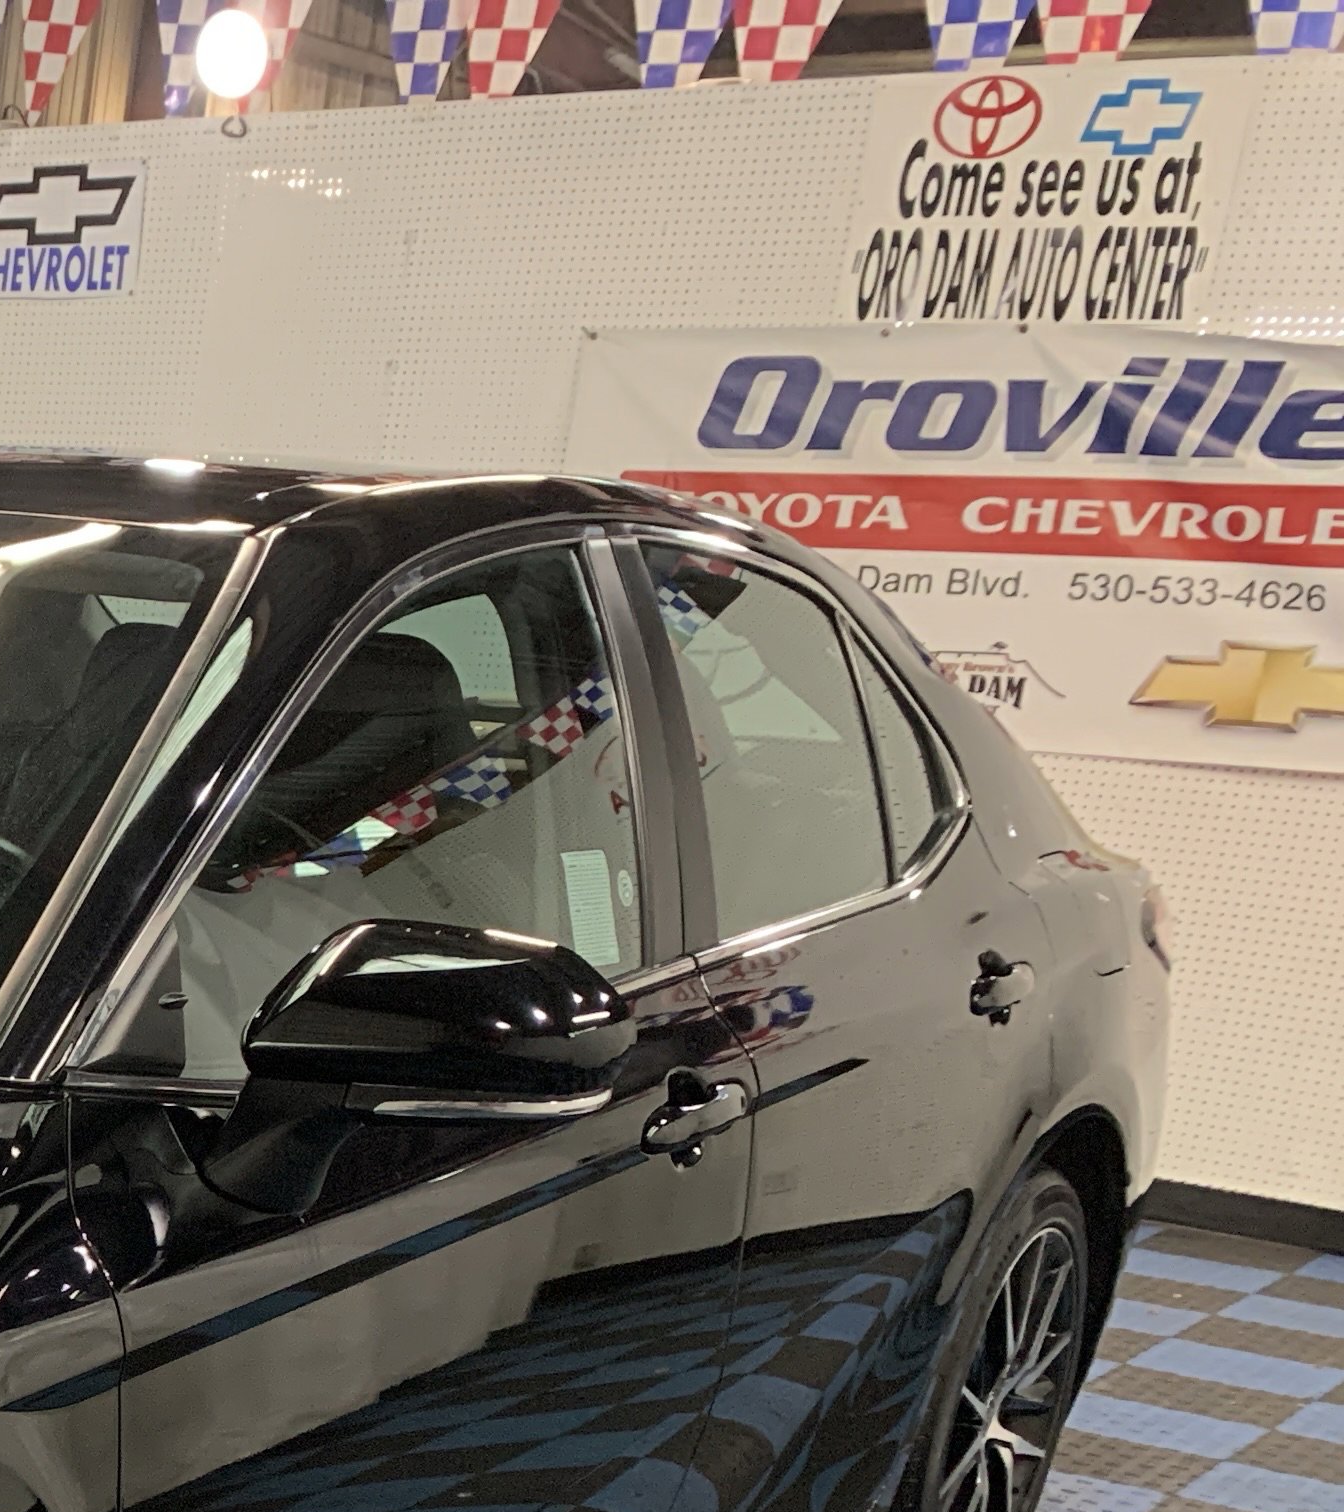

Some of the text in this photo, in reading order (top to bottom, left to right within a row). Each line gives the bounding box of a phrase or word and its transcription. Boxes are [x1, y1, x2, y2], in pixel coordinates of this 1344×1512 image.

[898, 138, 1204, 221] Come see us at,
[852, 225, 1209, 322] "ORO DAM AUTO CENTER"
[697, 355, 1344, 461] Oroville
[858, 565, 1327, 613] Dam Blvd. 530-533-4626
[967, 672, 1028, 709] DAM
